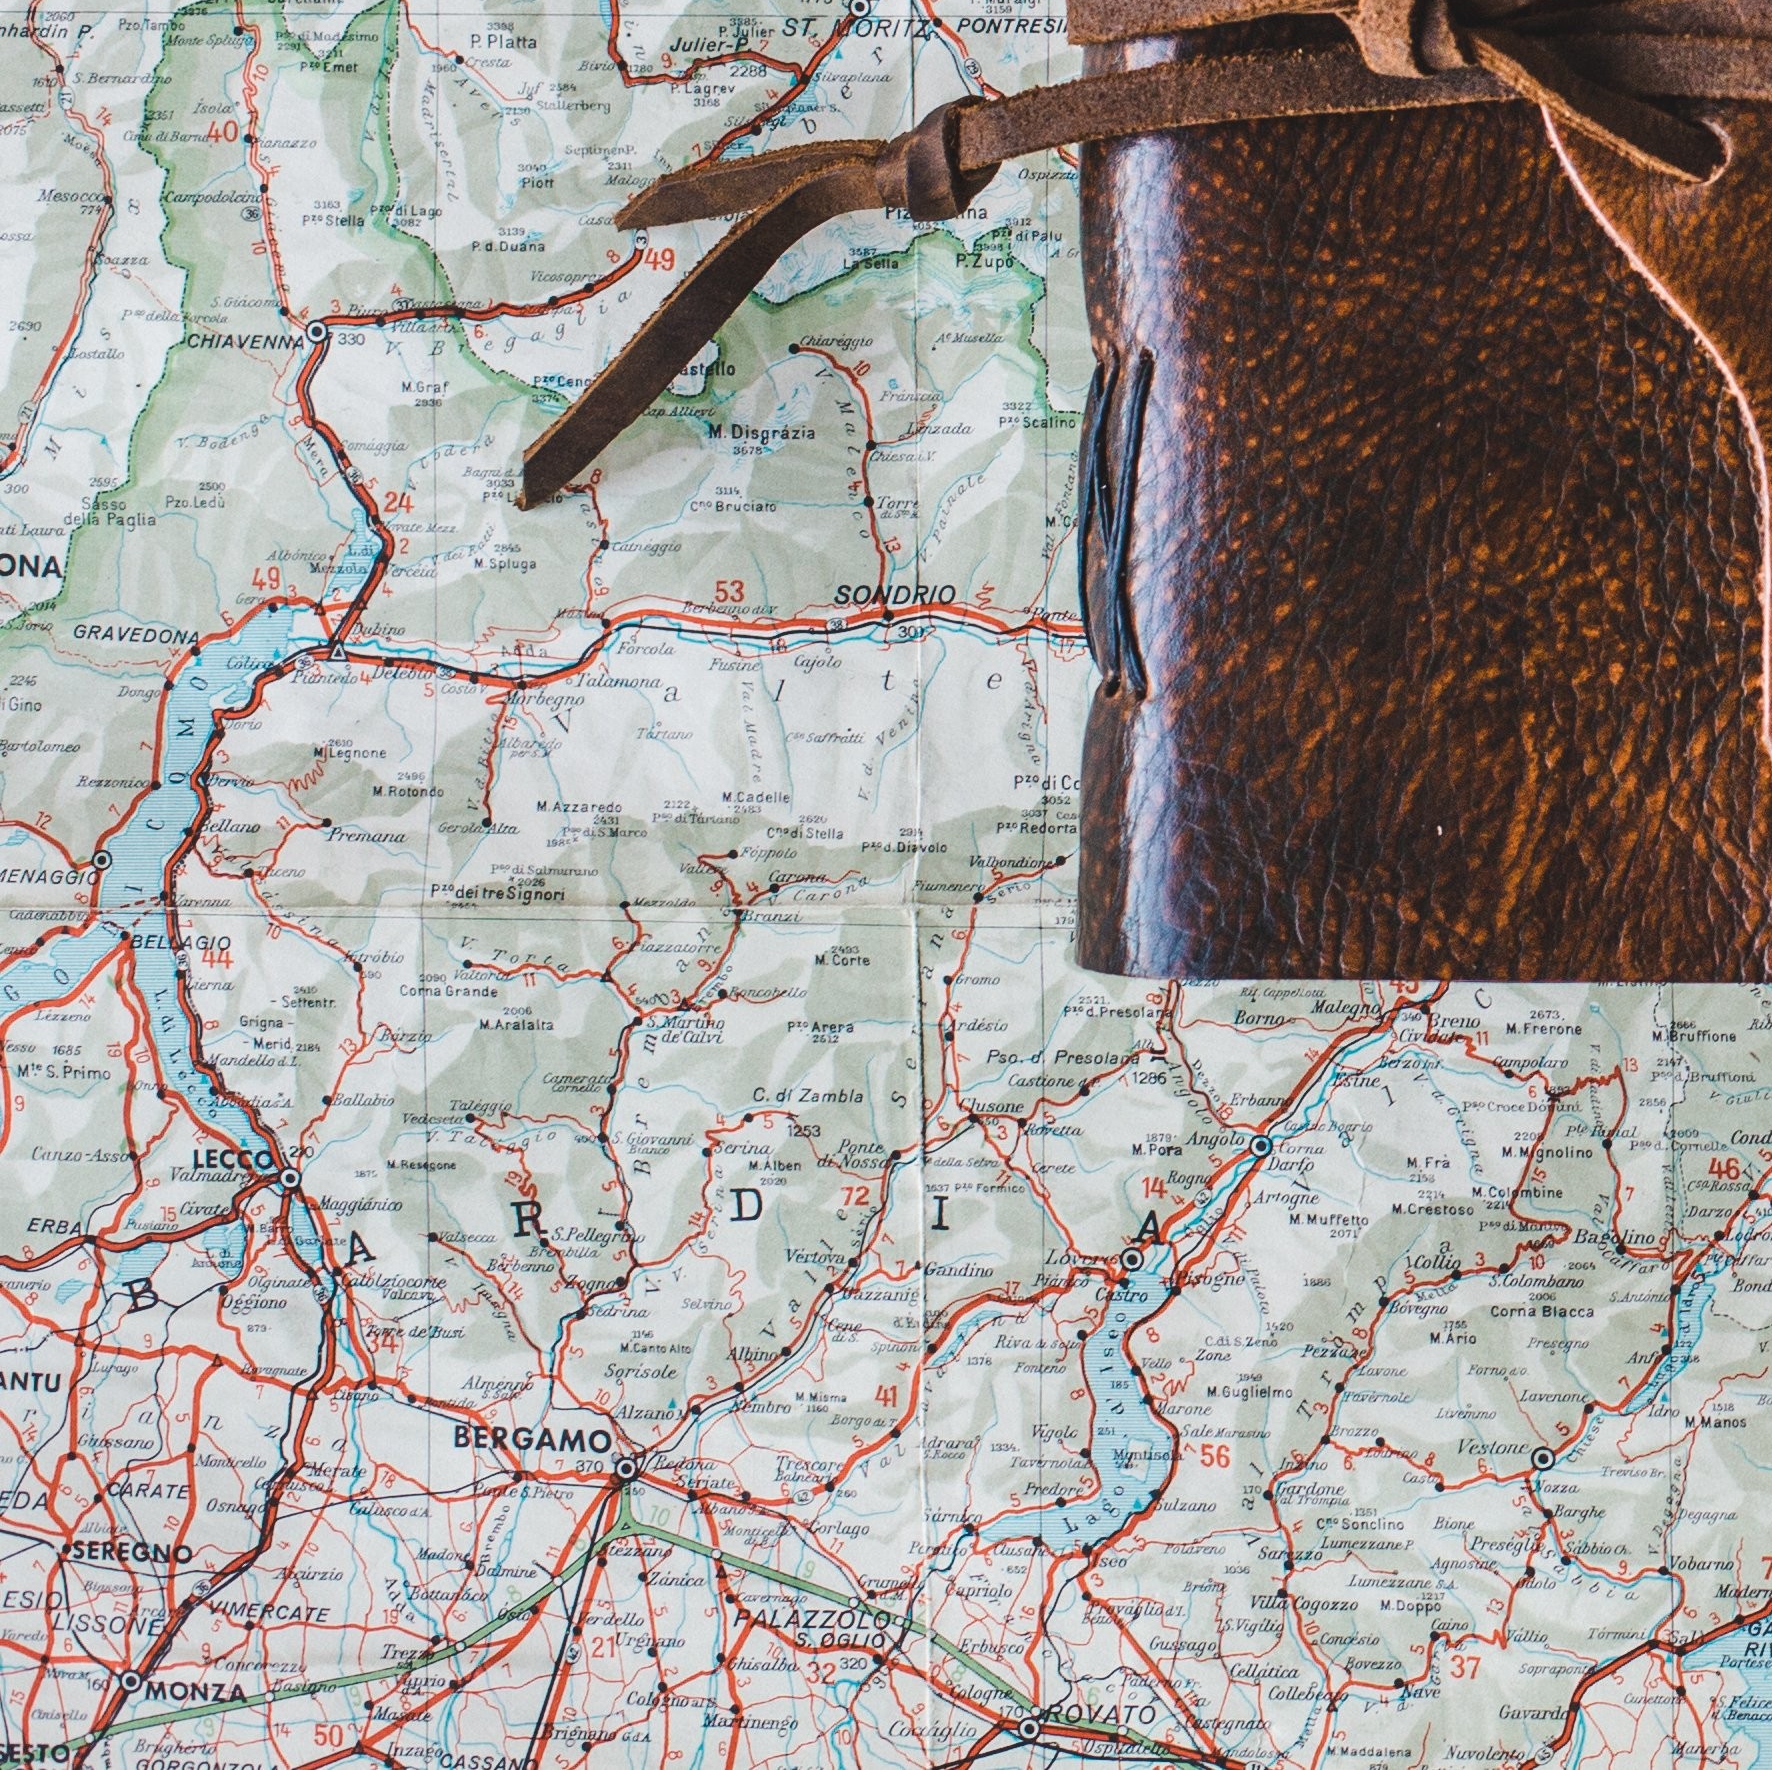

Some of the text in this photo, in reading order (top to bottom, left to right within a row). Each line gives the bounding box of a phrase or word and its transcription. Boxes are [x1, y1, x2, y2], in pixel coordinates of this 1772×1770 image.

[205, 121, 238, 143] 40
[642, 248, 674, 271] 49
[185, 332, 307, 350] CHIAVENNA
[338, 333, 365, 345] 330
[74, 623, 200, 647] GRAVEDONA
[574, 673, 660, 693] Talamona
[325, 827, 405, 844] Premana
[130, 933, 230, 953] BELLAGIO
[200, 947, 233, 968] 44
[193, 1147, 274, 1172] LECCO
[27, 1218, 84, 1237] ERBA
[1414, 1255, 1462, 1273] Collio
[455, 1425, 613, 1454] BERGAMO
[1458, 1439, 1530, 1454] Vestone
[1201, 1444, 1230, 1467] 56
[71, 1540, 193, 1564] SEREGNO
[734, 1607, 891, 1631] PALAZZOLO
[1451, 1655, 1480, 1679] 37
[144, 1680, 249, 1704] MONZA
[1044, 1701, 1155, 1727] ROVATO
[315, 1723, 343, 1747] 50
